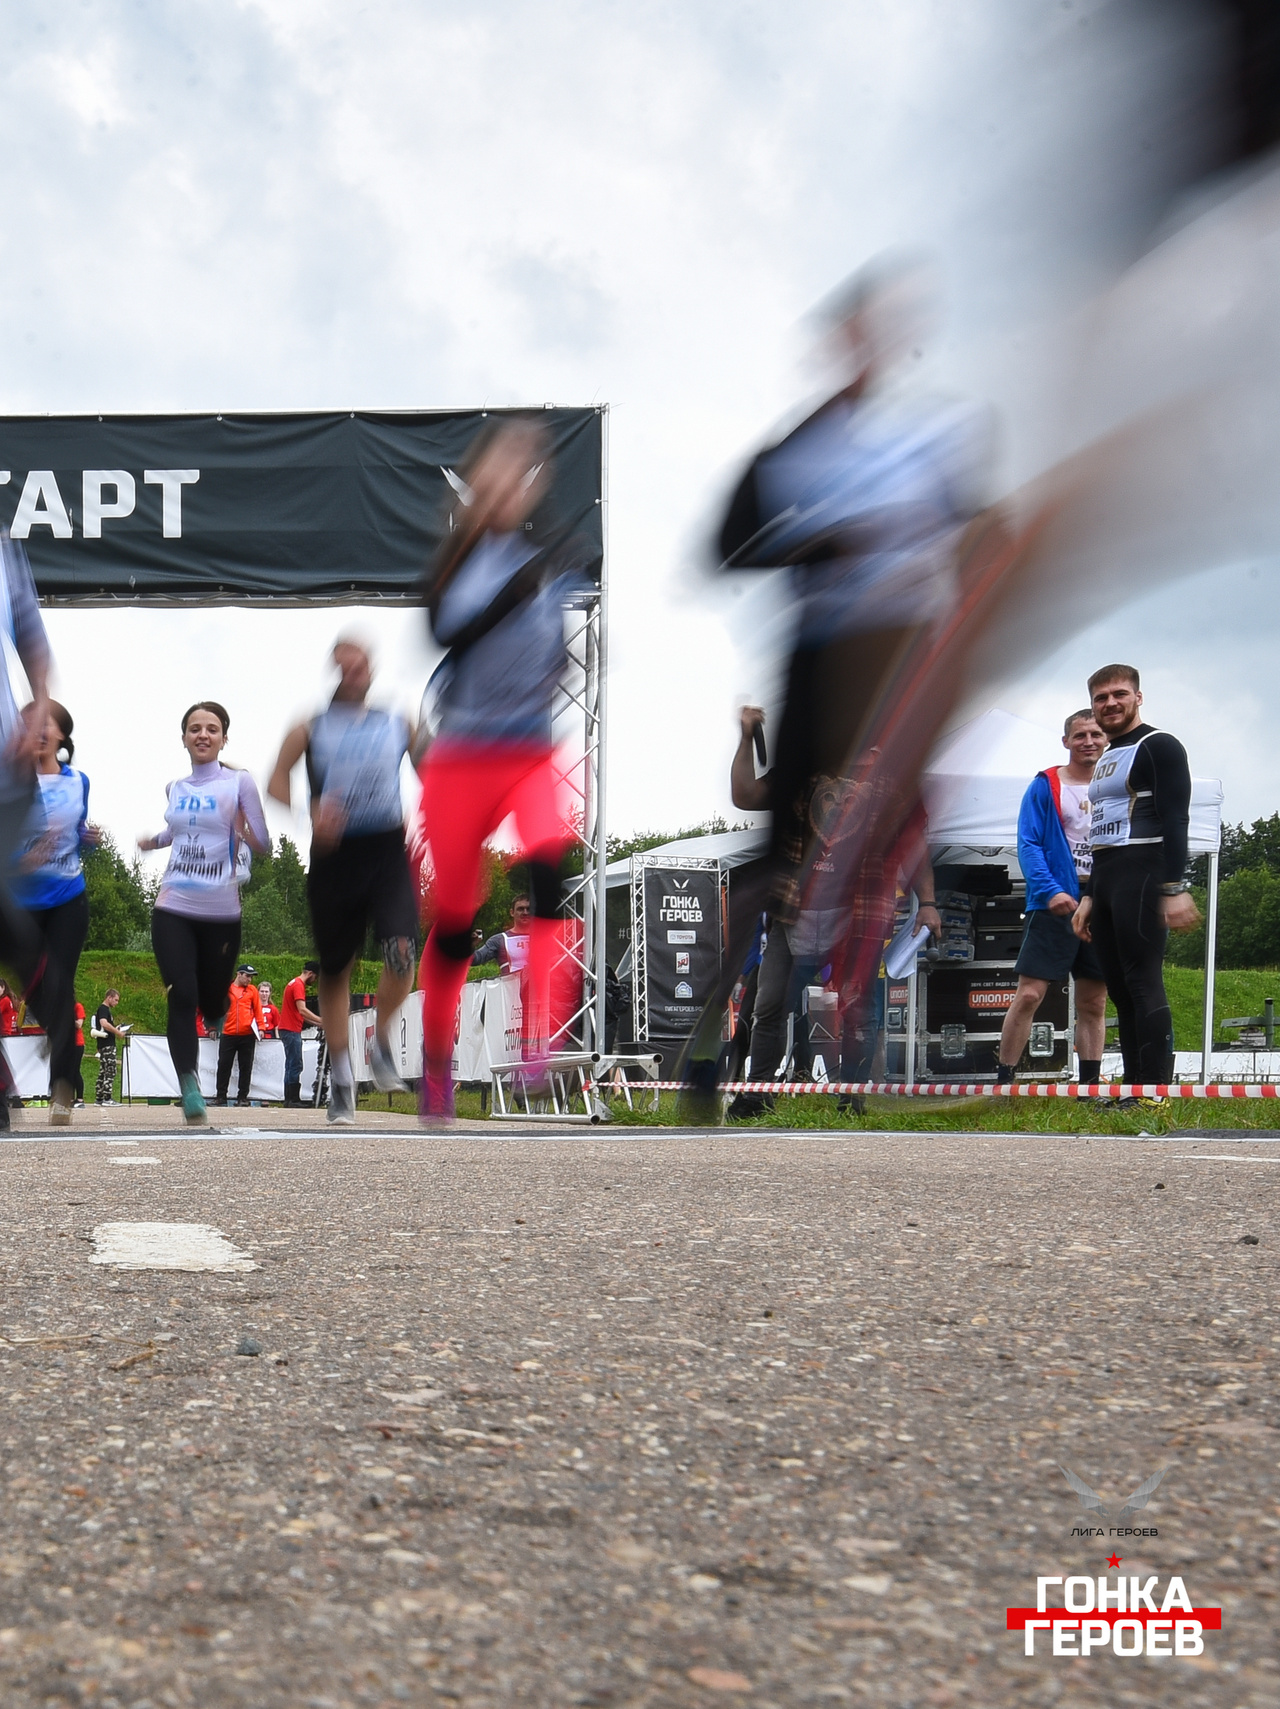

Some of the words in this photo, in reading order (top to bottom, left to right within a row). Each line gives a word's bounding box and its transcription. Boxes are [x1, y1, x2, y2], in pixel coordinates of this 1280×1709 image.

[662, 895, 700, 909] ГОНКА
[659, 909, 703, 922] ГЕРОЕВ
[972, 993, 1002, 1003] UNION
